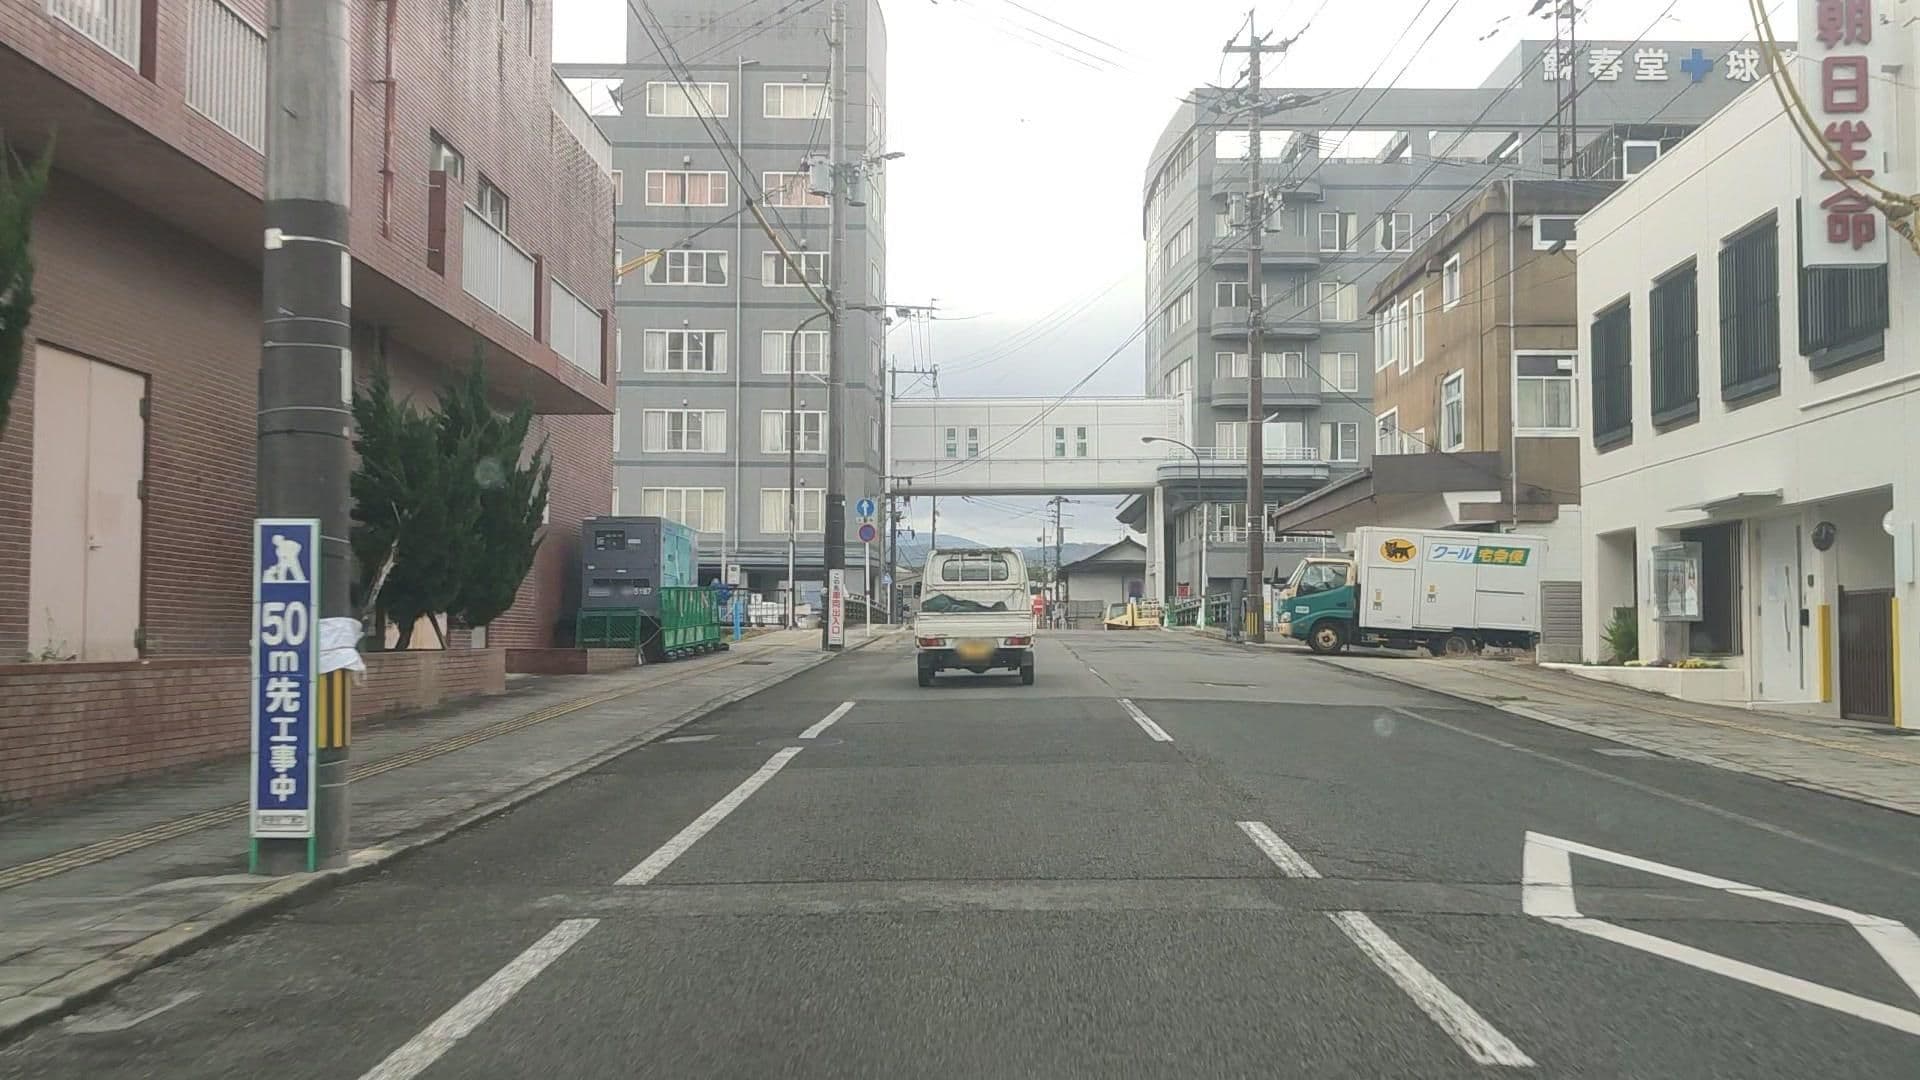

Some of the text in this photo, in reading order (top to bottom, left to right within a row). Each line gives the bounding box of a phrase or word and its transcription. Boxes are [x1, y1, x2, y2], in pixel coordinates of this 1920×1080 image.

[1816, 0, 1876, 250] 朝日生命
[261, 600, 308, 803] 50m先工事中
